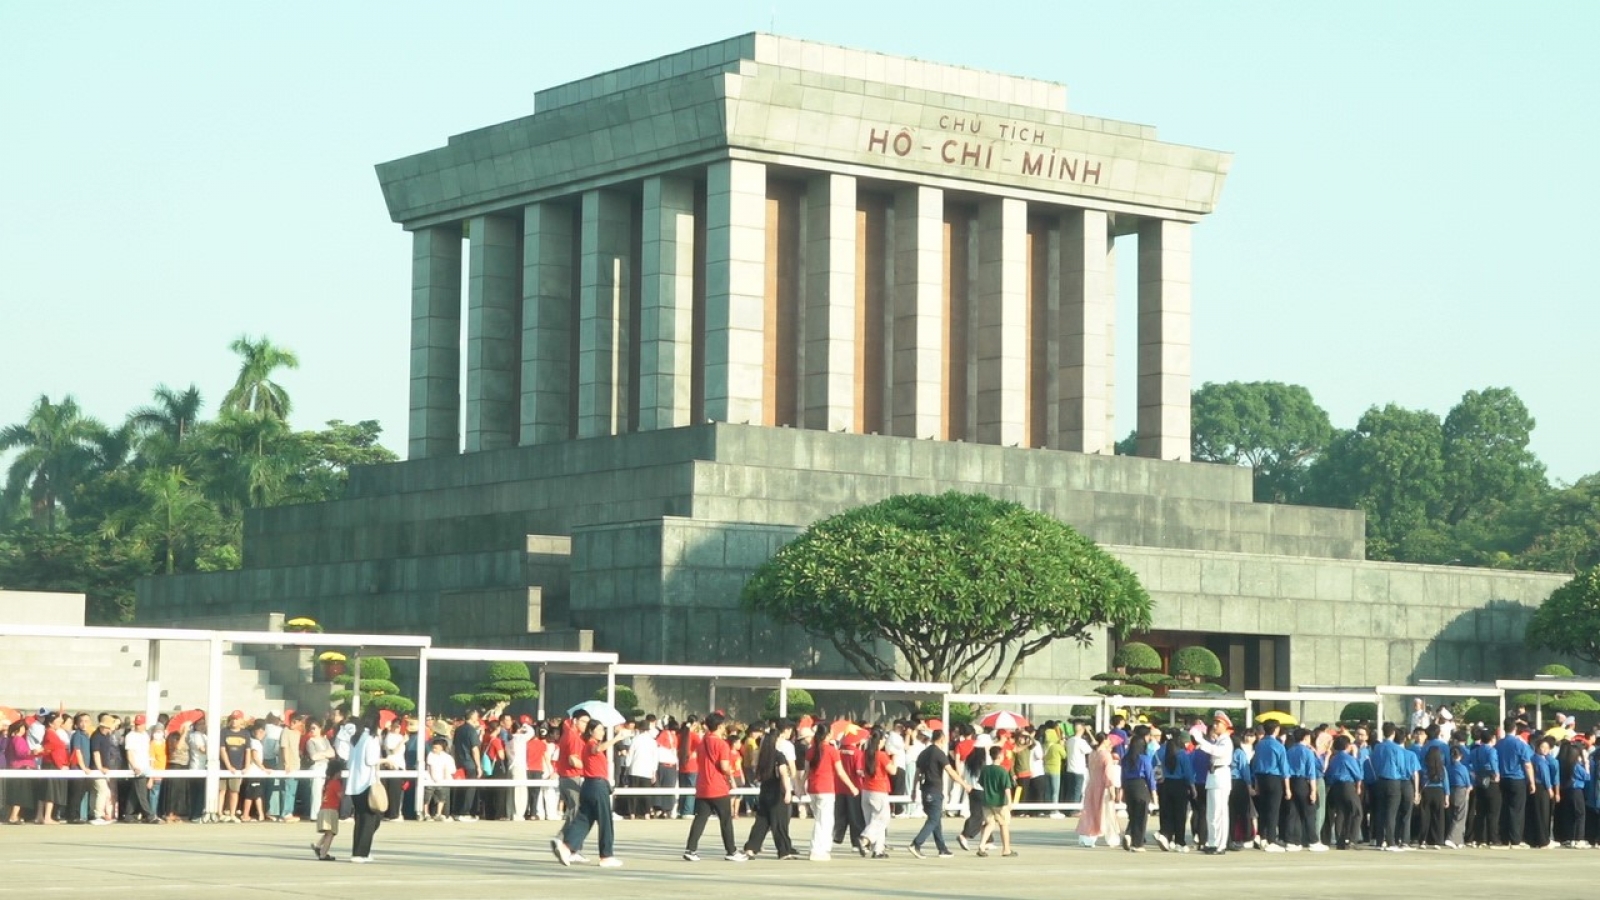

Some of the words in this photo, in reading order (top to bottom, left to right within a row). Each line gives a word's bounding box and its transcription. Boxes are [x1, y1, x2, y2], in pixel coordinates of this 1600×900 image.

[867, 127, 915, 157] HỒ
[941, 139, 996, 170] CHÍ
[1021, 148, 1102, 185] MINH
